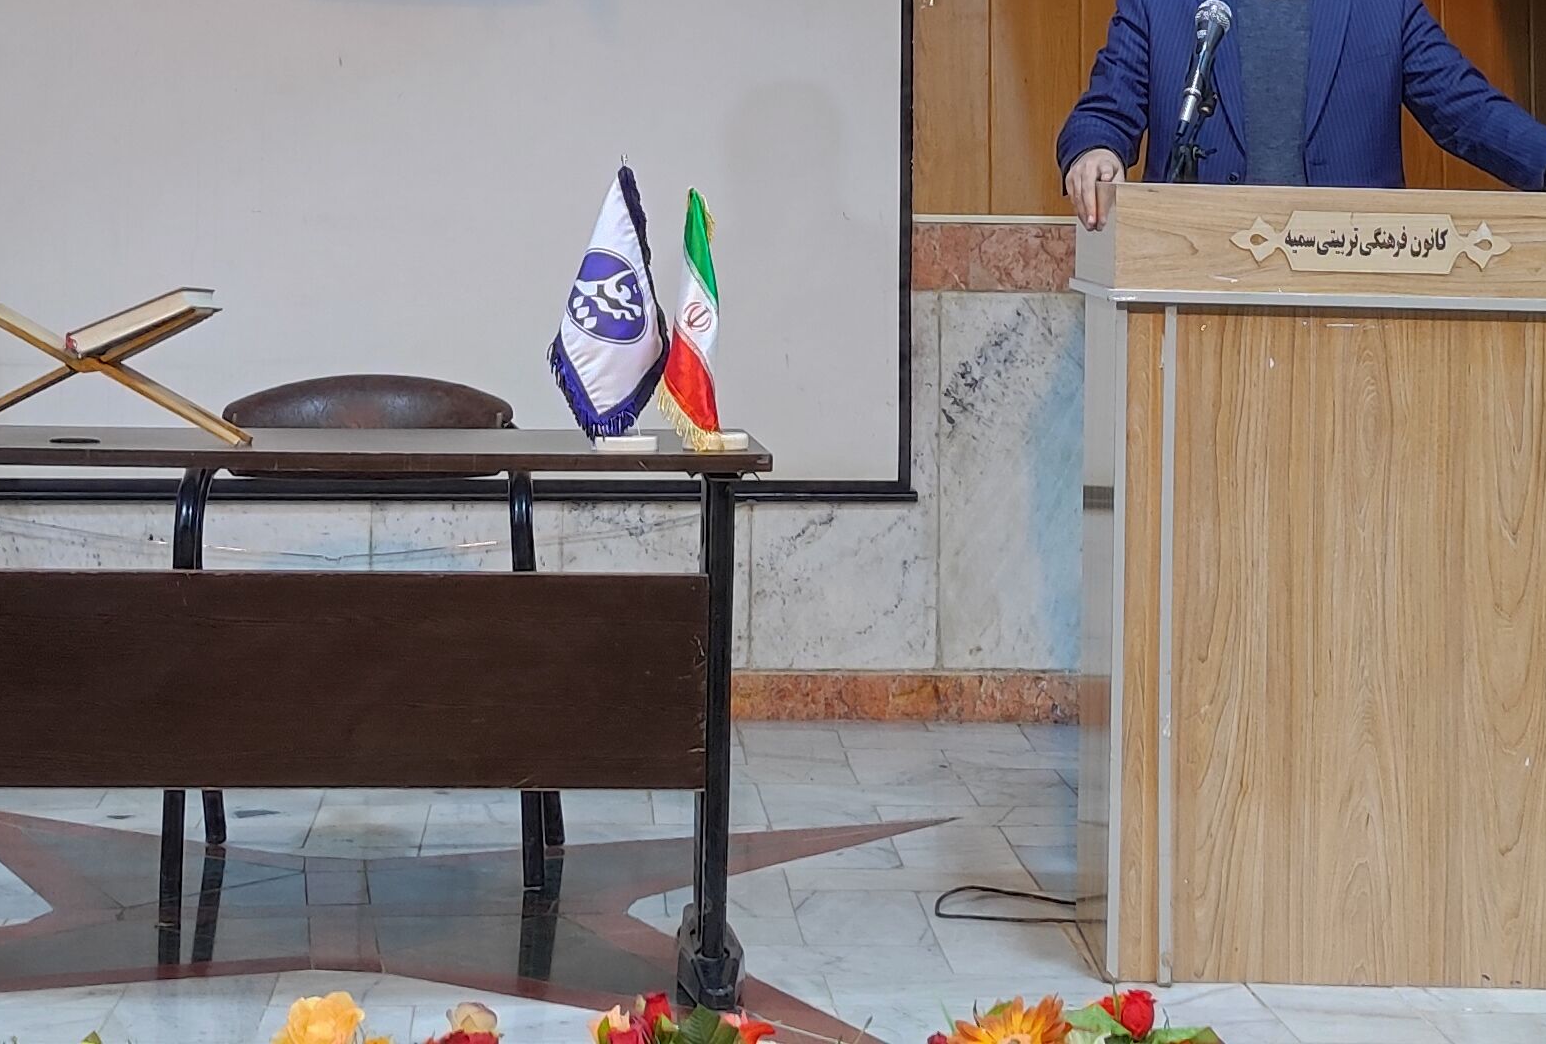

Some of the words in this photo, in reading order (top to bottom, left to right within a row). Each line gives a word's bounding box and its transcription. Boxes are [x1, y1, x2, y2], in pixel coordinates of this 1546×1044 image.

[1285, 230, 1315, 253] سمیه
[1359, 226, 1407, 257] فرهنگی
[1410, 228, 1448, 258] کانون
